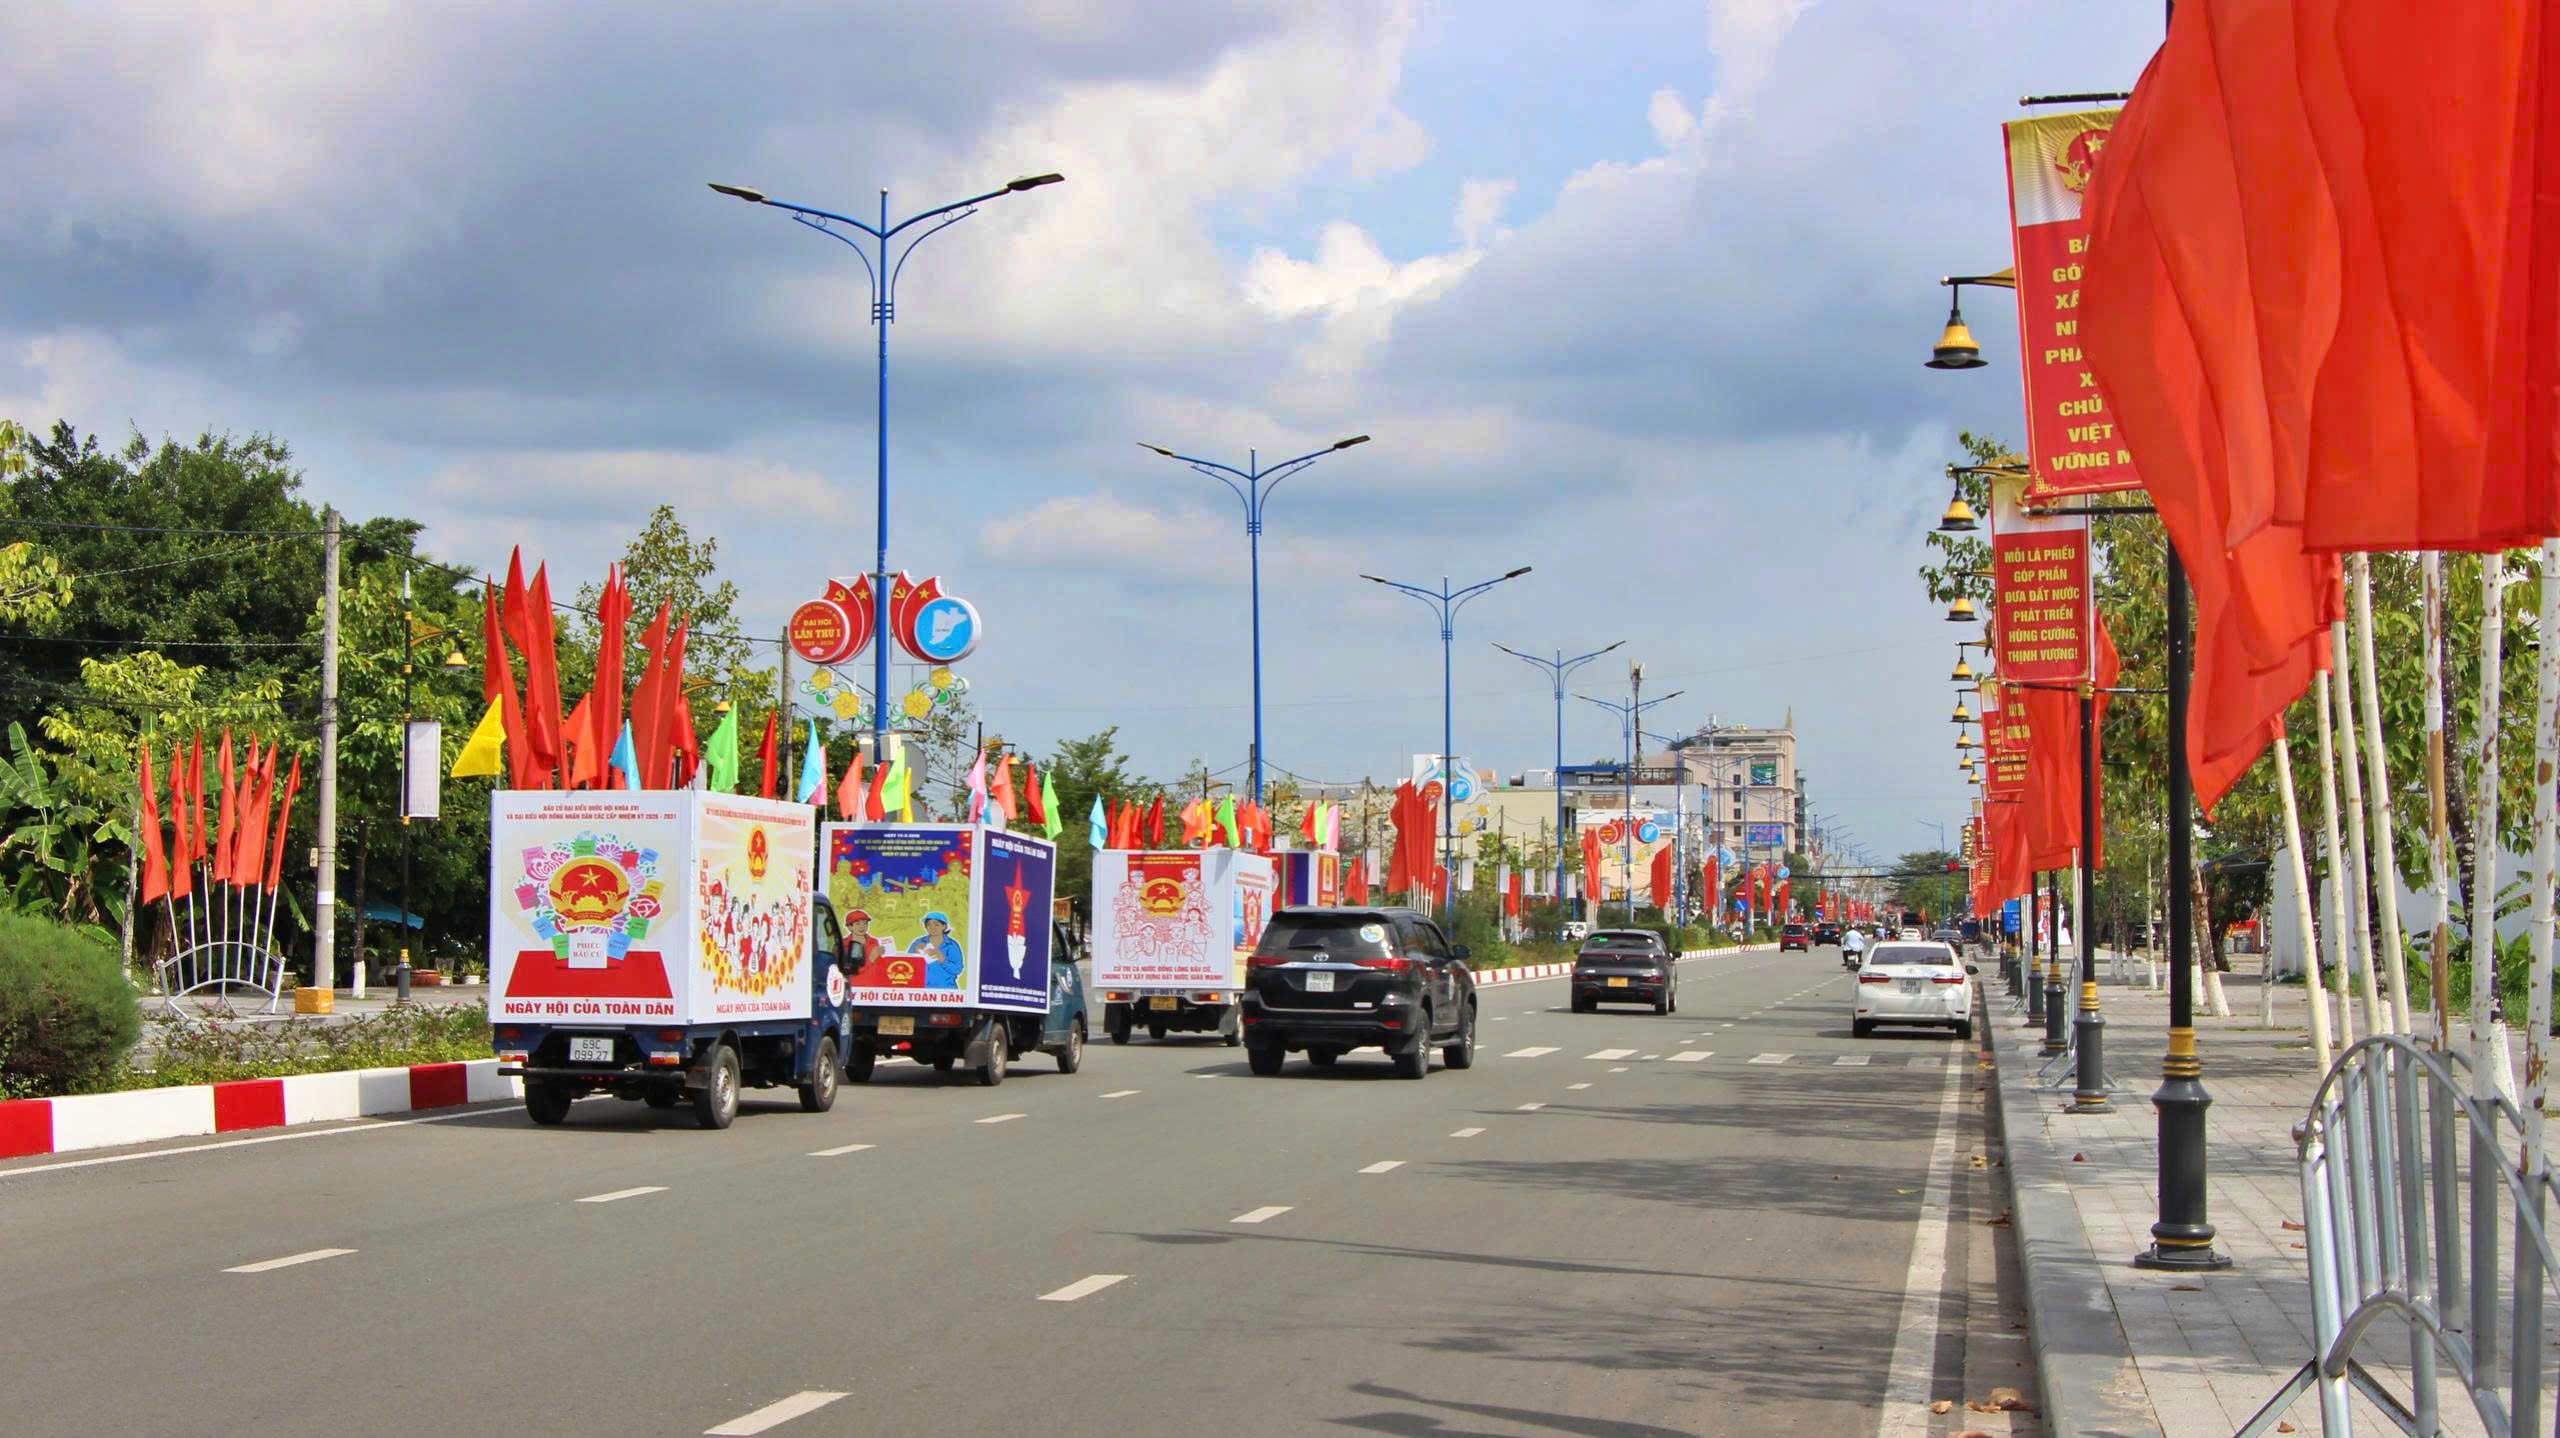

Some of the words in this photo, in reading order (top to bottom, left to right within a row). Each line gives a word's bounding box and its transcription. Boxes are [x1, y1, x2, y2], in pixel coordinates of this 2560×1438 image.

[2053, 263, 2084, 283] GÓ
[2080, 372, 2097, 388] X
[2059, 393, 2103, 416] CHỦ
[2067, 422, 2113, 444] VIỆT
[2051, 451, 2110, 471] VỮNG
[2117, 450, 2134, 465] M
[2044, 544, 2075, 561] PHIẾU
[2014, 568, 2035, 583] GÓP
[2005, 589, 2026, 603] ĐƯA
[2029, 585, 2049, 602] ĐẤT
[2052, 584, 2080, 601] NƯỚC
[2014, 607, 2040, 623] PHÁT
[2043, 603, 2074, 621] TRIỂN
[2007, 650, 2037, 665] THỊNH
[2040, 647, 2078, 663] VƯỢNG!
[860, 991, 879, 1003] HỘI
[882, 989, 904, 1002] CỦA
[908, 991, 937, 1002] TOÀN
[941, 992, 964, 1003] DÂN
[505, 1001, 542, 1014] NGÀY
[546, 1001, 569, 1016] HỘI
[573, 998, 601, 1014] CỦA
[605, 1001, 641, 1015] TOÀN
[645, 1002, 674, 1015] DÂN
